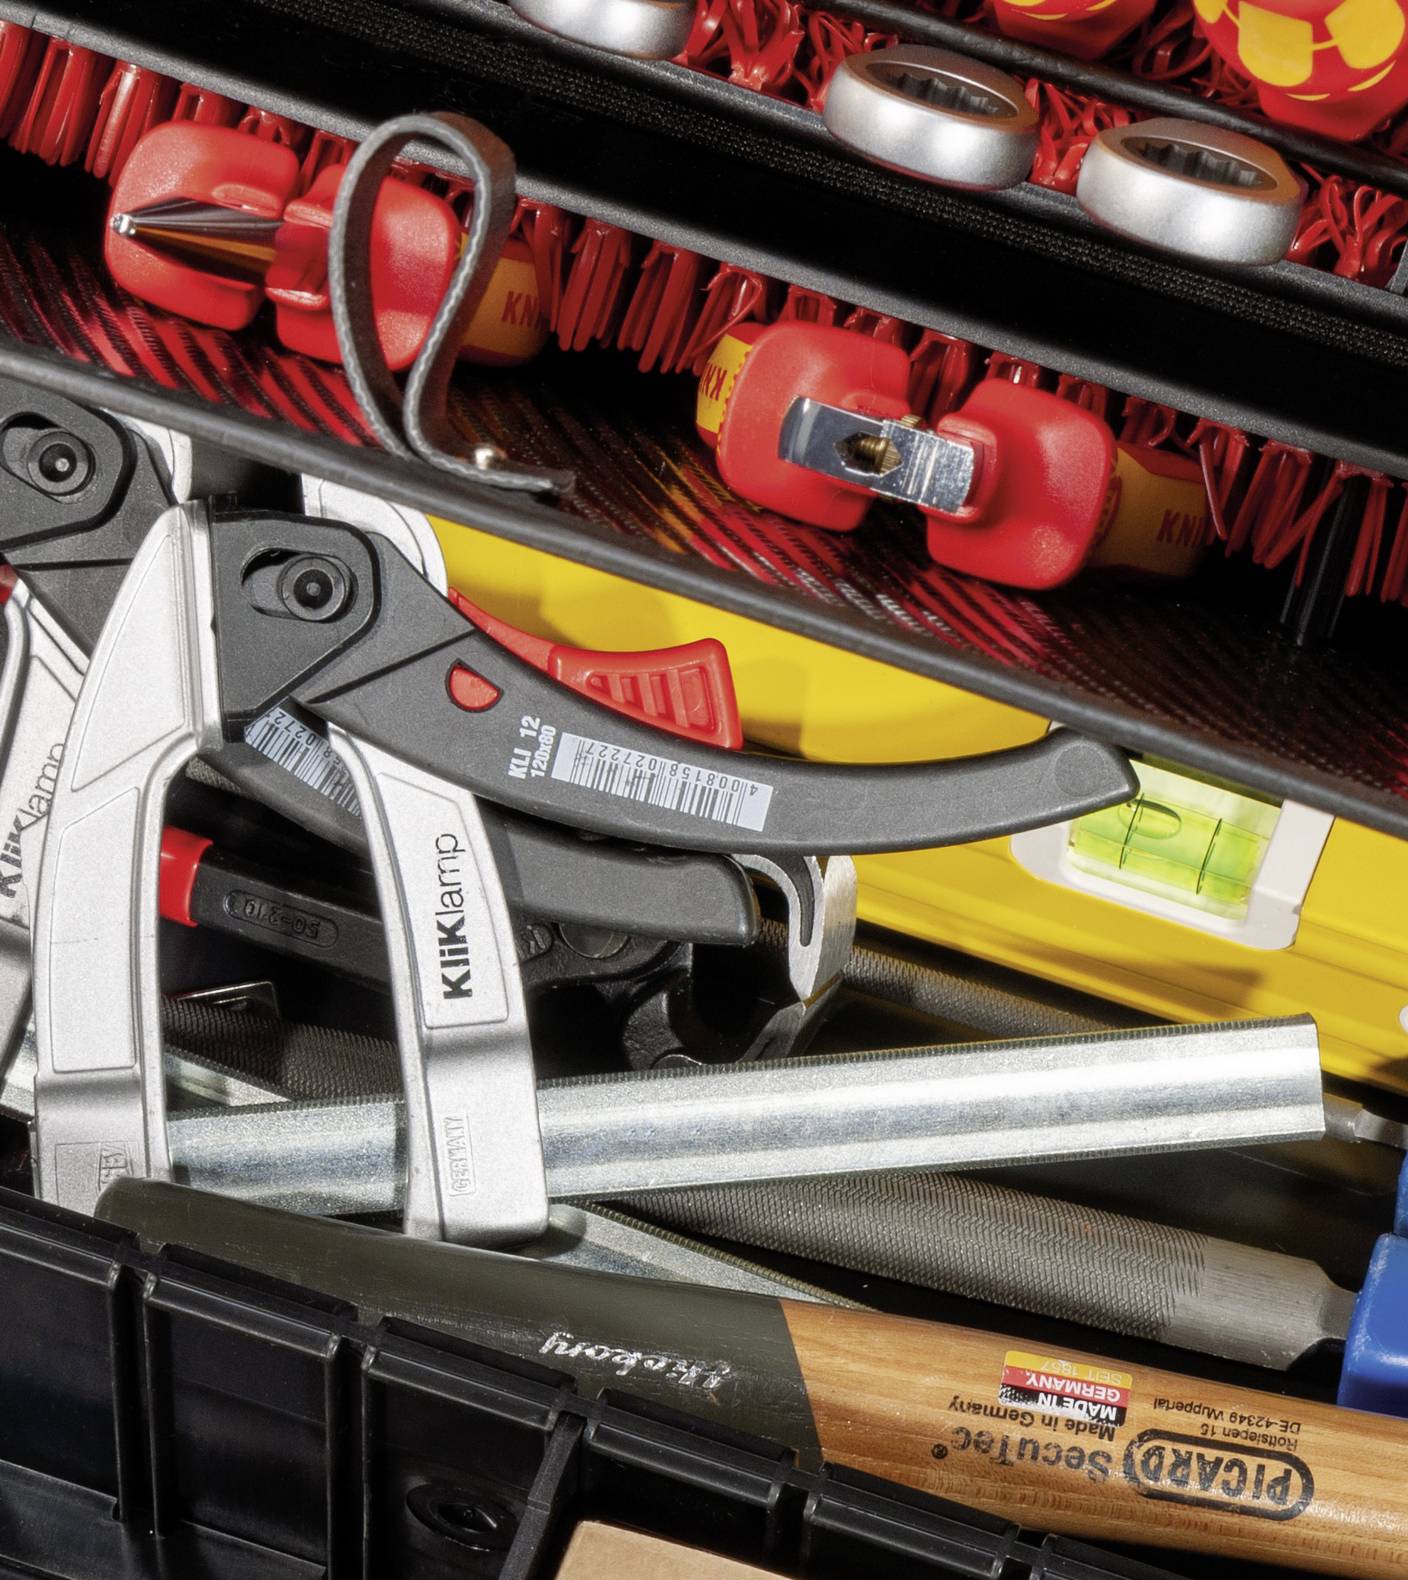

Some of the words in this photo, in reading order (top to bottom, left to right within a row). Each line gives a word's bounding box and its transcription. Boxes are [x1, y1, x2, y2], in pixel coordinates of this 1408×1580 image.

[518, 714, 541, 739] 12
[507, 748, 531, 779] KLI
[529, 724, 556, 777] 120x80
[442, 1117, 470, 1191] GERMANY
[947, 1394, 1035, 1428] Germany
[1058, 1395, 1117, 1420] MADE
[1152, 1395, 1224, 1420] Wuppertal
[1063, 1418, 1116, 1441] Made
[1136, 1443, 1293, 1504] PICARD
